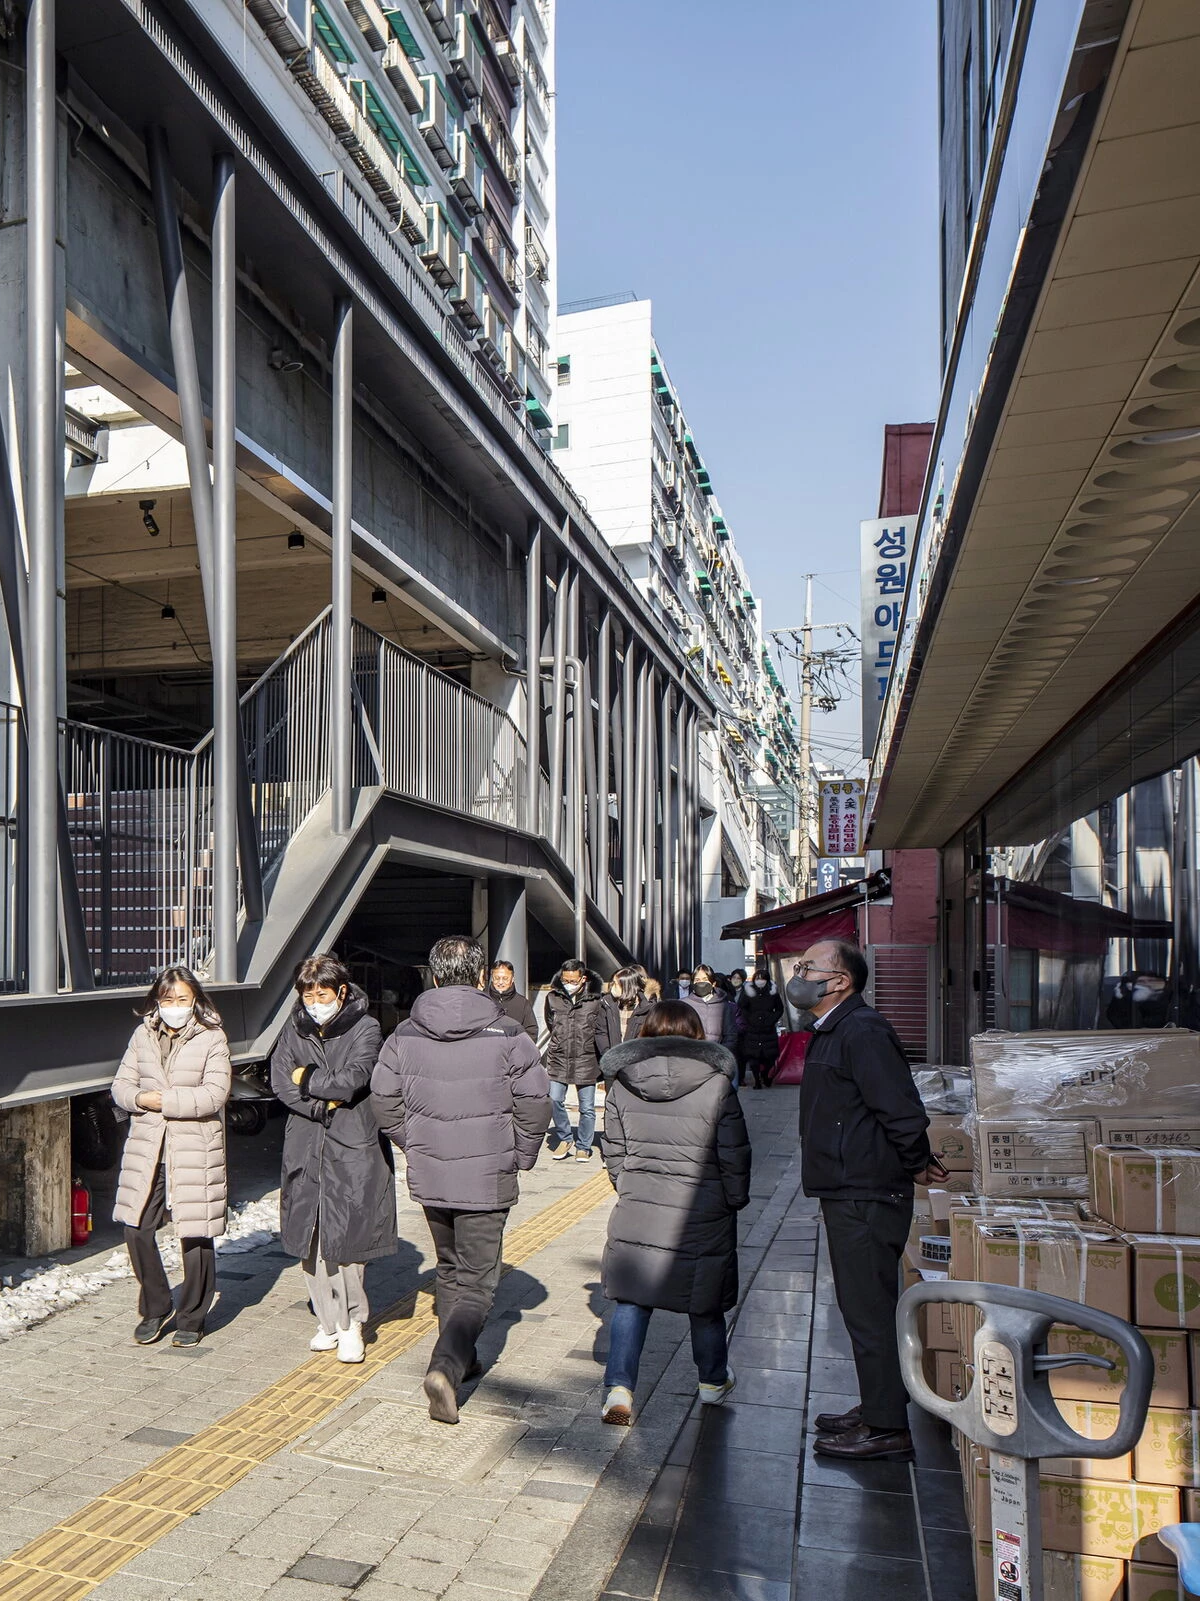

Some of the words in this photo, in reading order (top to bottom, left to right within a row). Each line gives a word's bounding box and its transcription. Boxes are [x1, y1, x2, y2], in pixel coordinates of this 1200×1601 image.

[844, 814, 856, 853] 생삼겹살
[824, 875, 832, 892] MG
[992, 1149, 1011, 1157] 수량
[993, 1162, 1013, 1170] 비고
[1001, 1496, 1021, 1506] Japan
